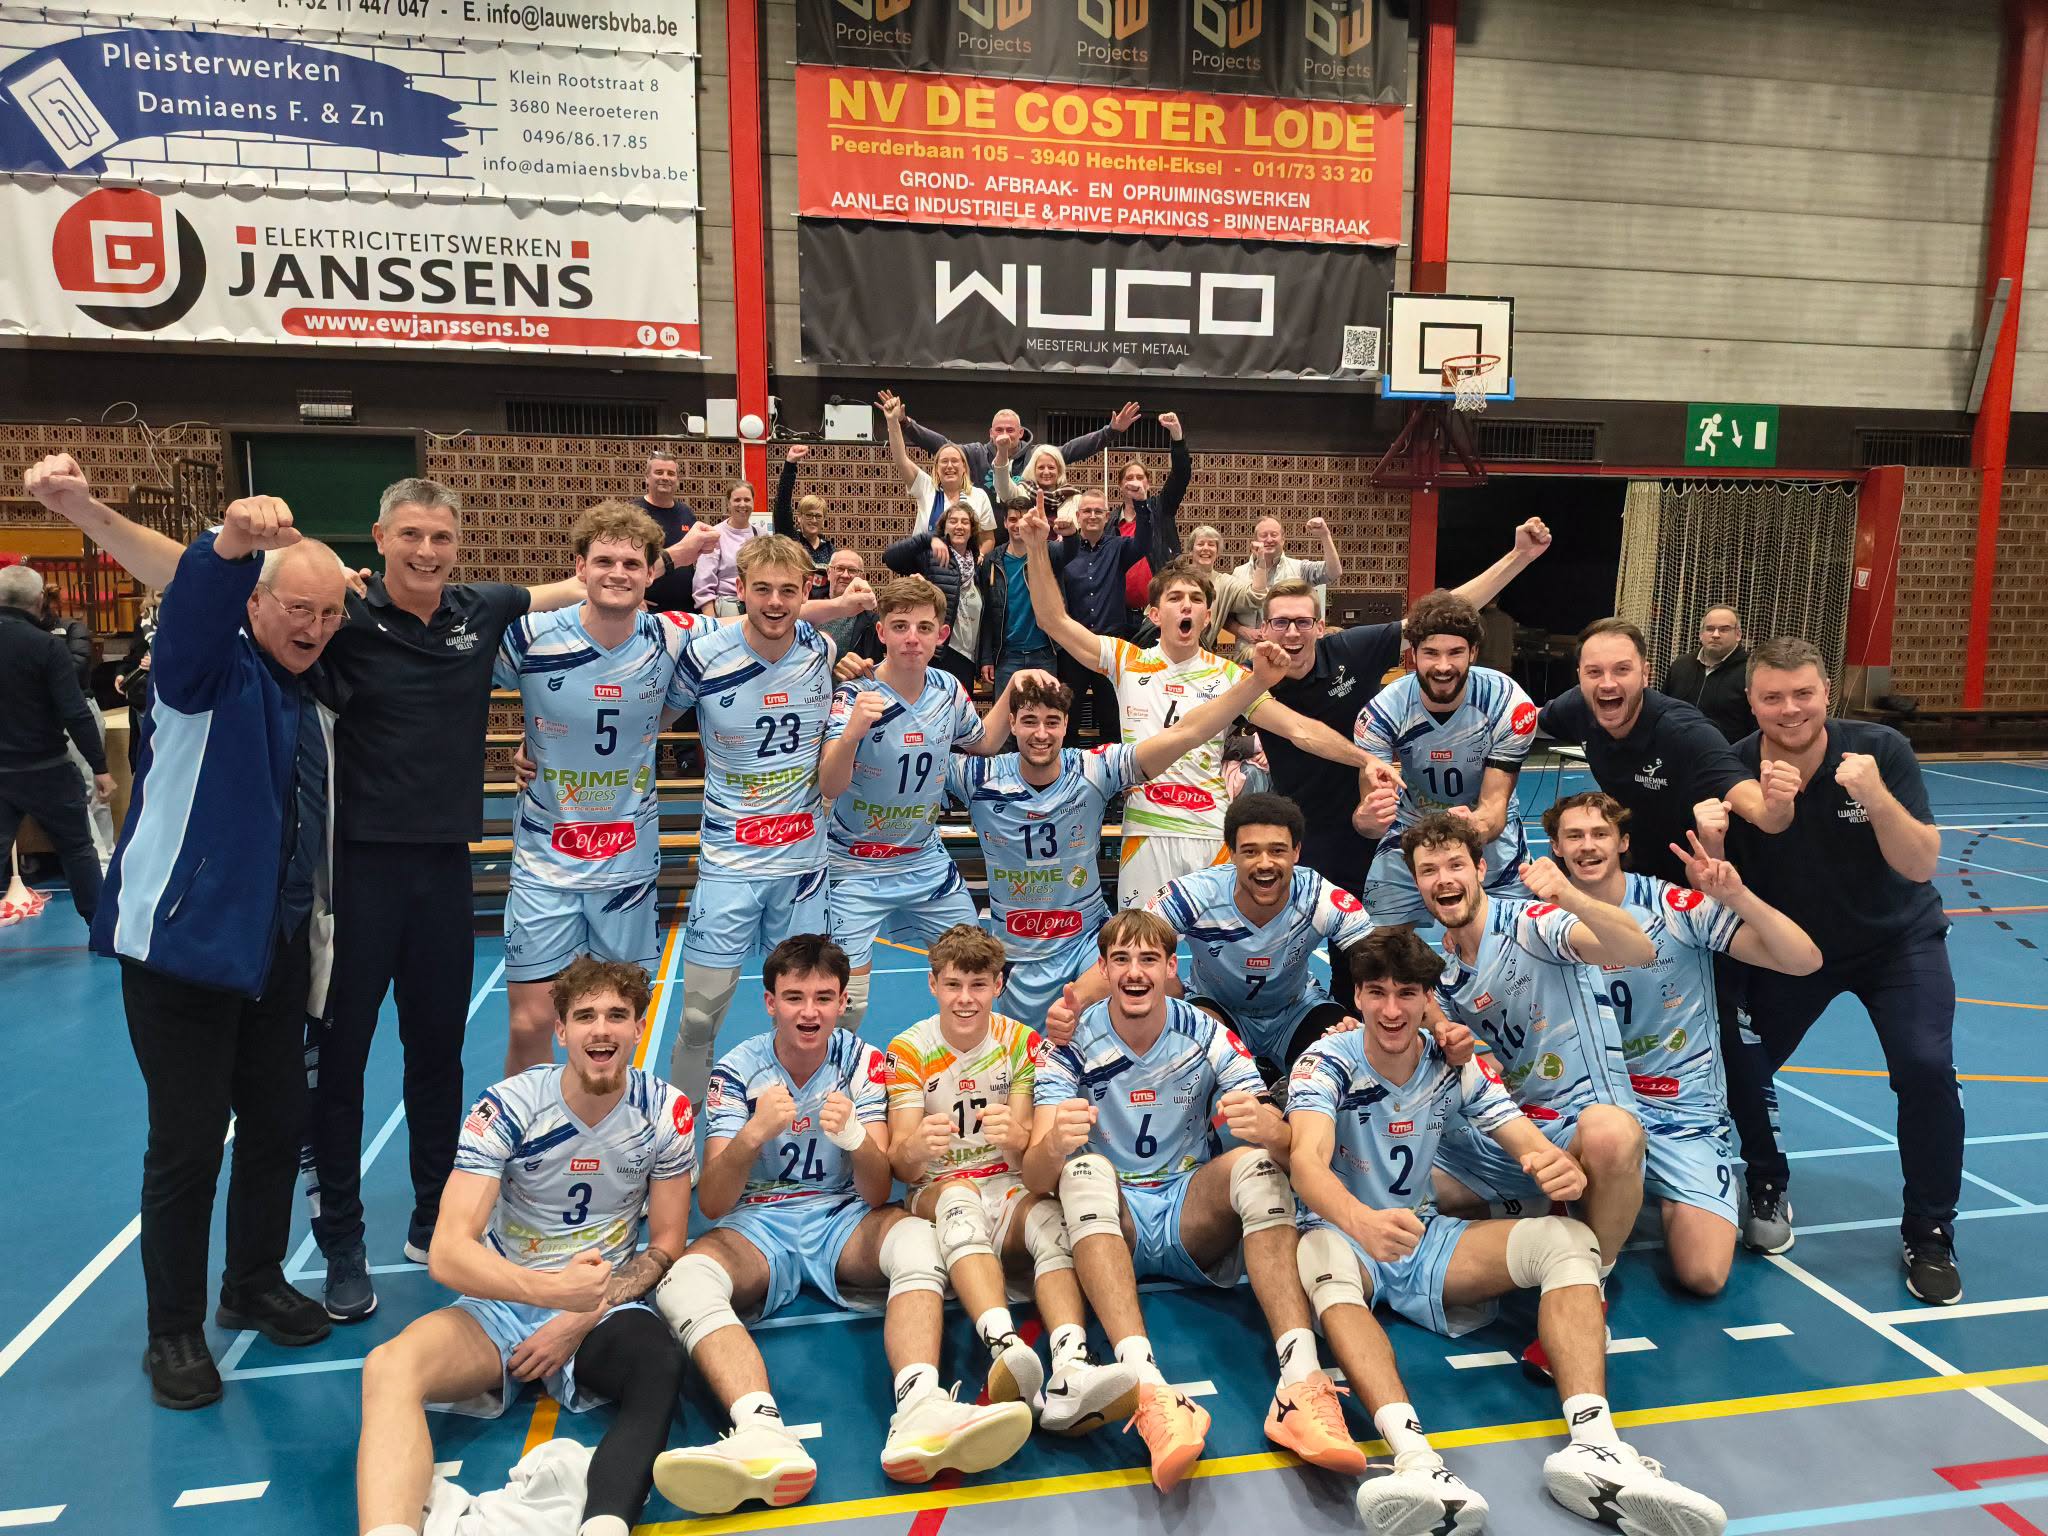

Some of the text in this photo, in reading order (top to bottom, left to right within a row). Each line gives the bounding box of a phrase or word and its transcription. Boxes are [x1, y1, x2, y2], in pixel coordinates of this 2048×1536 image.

[400, 0, 428, 17] 047
[464, 2, 481, 22] E.
[487, 4, 678, 37] info@lauwersbvba.be
[836, 22, 912, 45] Projects
[958, 31, 1032, 54] Projects
[1077, 40, 1148, 63] Projects
[103, 43, 341, 83] Pleisterwerken
[1192, 50, 1261, 72] Projects
[1303, 57, 1371, 79] Projects
[510, 70, 659, 92] Klein Rootstraat 8
[138, 91, 384, 127] Damiaens F. & Zn
[510, 99, 659, 121] 3680 Neeroeteren
[829, 78, 1375, 152] NV DE COSTER LODE
[523, 129, 648, 150] 0496/86.17.85
[483, 156, 688, 181] info@damiaensbvba.be
[831, 135, 964, 160] Peerderbaan
[971, 144, 1009, 162] 105
[1031, 148, 1080, 167] 3940
[1086, 151, 1222, 176] Hechtel-Eksel
[1253, 160, 1316, 181] 011/73
[1321, 165, 1345, 182] 33
[1350, 167, 1373, 183] 20
[900, 170, 1310, 208] GROND- AFBRAAK- EN OPRUIMINGSWERKEN
[831, 192, 909, 212] AANLEG
[914, 197, 1036, 219] INDUSTRIELE
[1041, 204, 1055, 220] &
[1059, 205, 1112, 223] PRIVE
[1118, 209, 1209, 229] PARKINGS
[1225, 213, 1371, 235] BINNENAFBRAAK
[265, 227, 562, 258] ELEKTRICITEITSWERKEN
[229, 251, 594, 309] JANSSENS
[935, 260, 1275, 337] WUCO
[304, 313, 550, 339] www.ewjanssens.be
[1027, 337, 1190, 356] MEESTERLIJK MET METAAL
[595, 709, 619, 756] 5
[756, 713, 800, 758] 23
[543, 767, 630, 788] PRIME
[897, 752, 932, 794] 19
[1422, 767, 1463, 797] 10
[852, 799, 925, 819] PRIME
[1018, 822, 1058, 859] 13
[993, 868, 1064, 884] PRIME
[1011, 912, 1079, 934] Colona
[1246, 975, 1267, 1000] 7
[1610, 979, 1633, 1025] 9
[1481, 1009, 1525, 1060] 14
[952, 1098, 987, 1139] 17
[1135, 1114, 1158, 1159] 6
[778, 1138, 827, 1183] 24
[1388, 1145, 1414, 1196] 2
[1716, 1164, 1730, 1198] 9
[562, 1182, 593, 1226] 3
